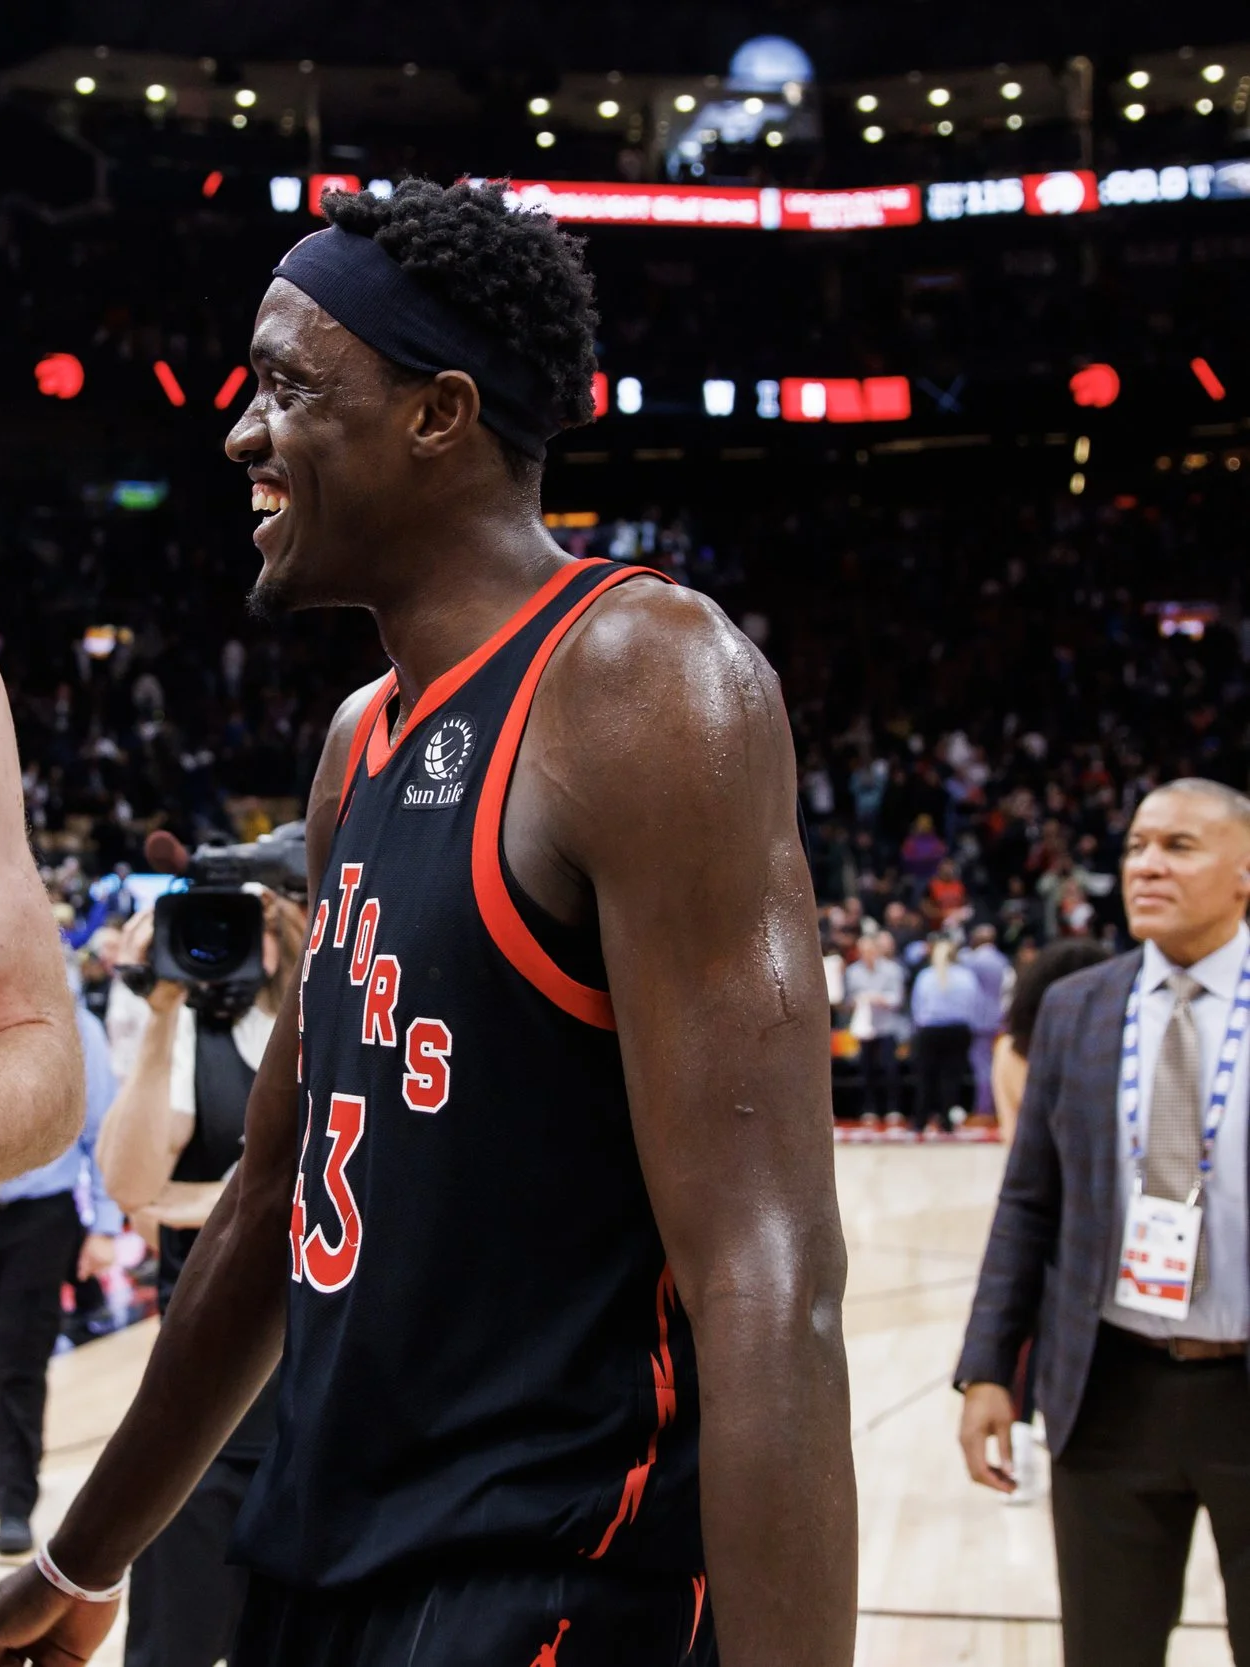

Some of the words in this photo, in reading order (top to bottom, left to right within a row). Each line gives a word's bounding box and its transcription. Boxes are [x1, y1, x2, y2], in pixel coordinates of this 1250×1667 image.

[403, 784, 435, 805] Sun
[436, 781, 465, 804] Life
[297, 862, 453, 1114] PTORS
